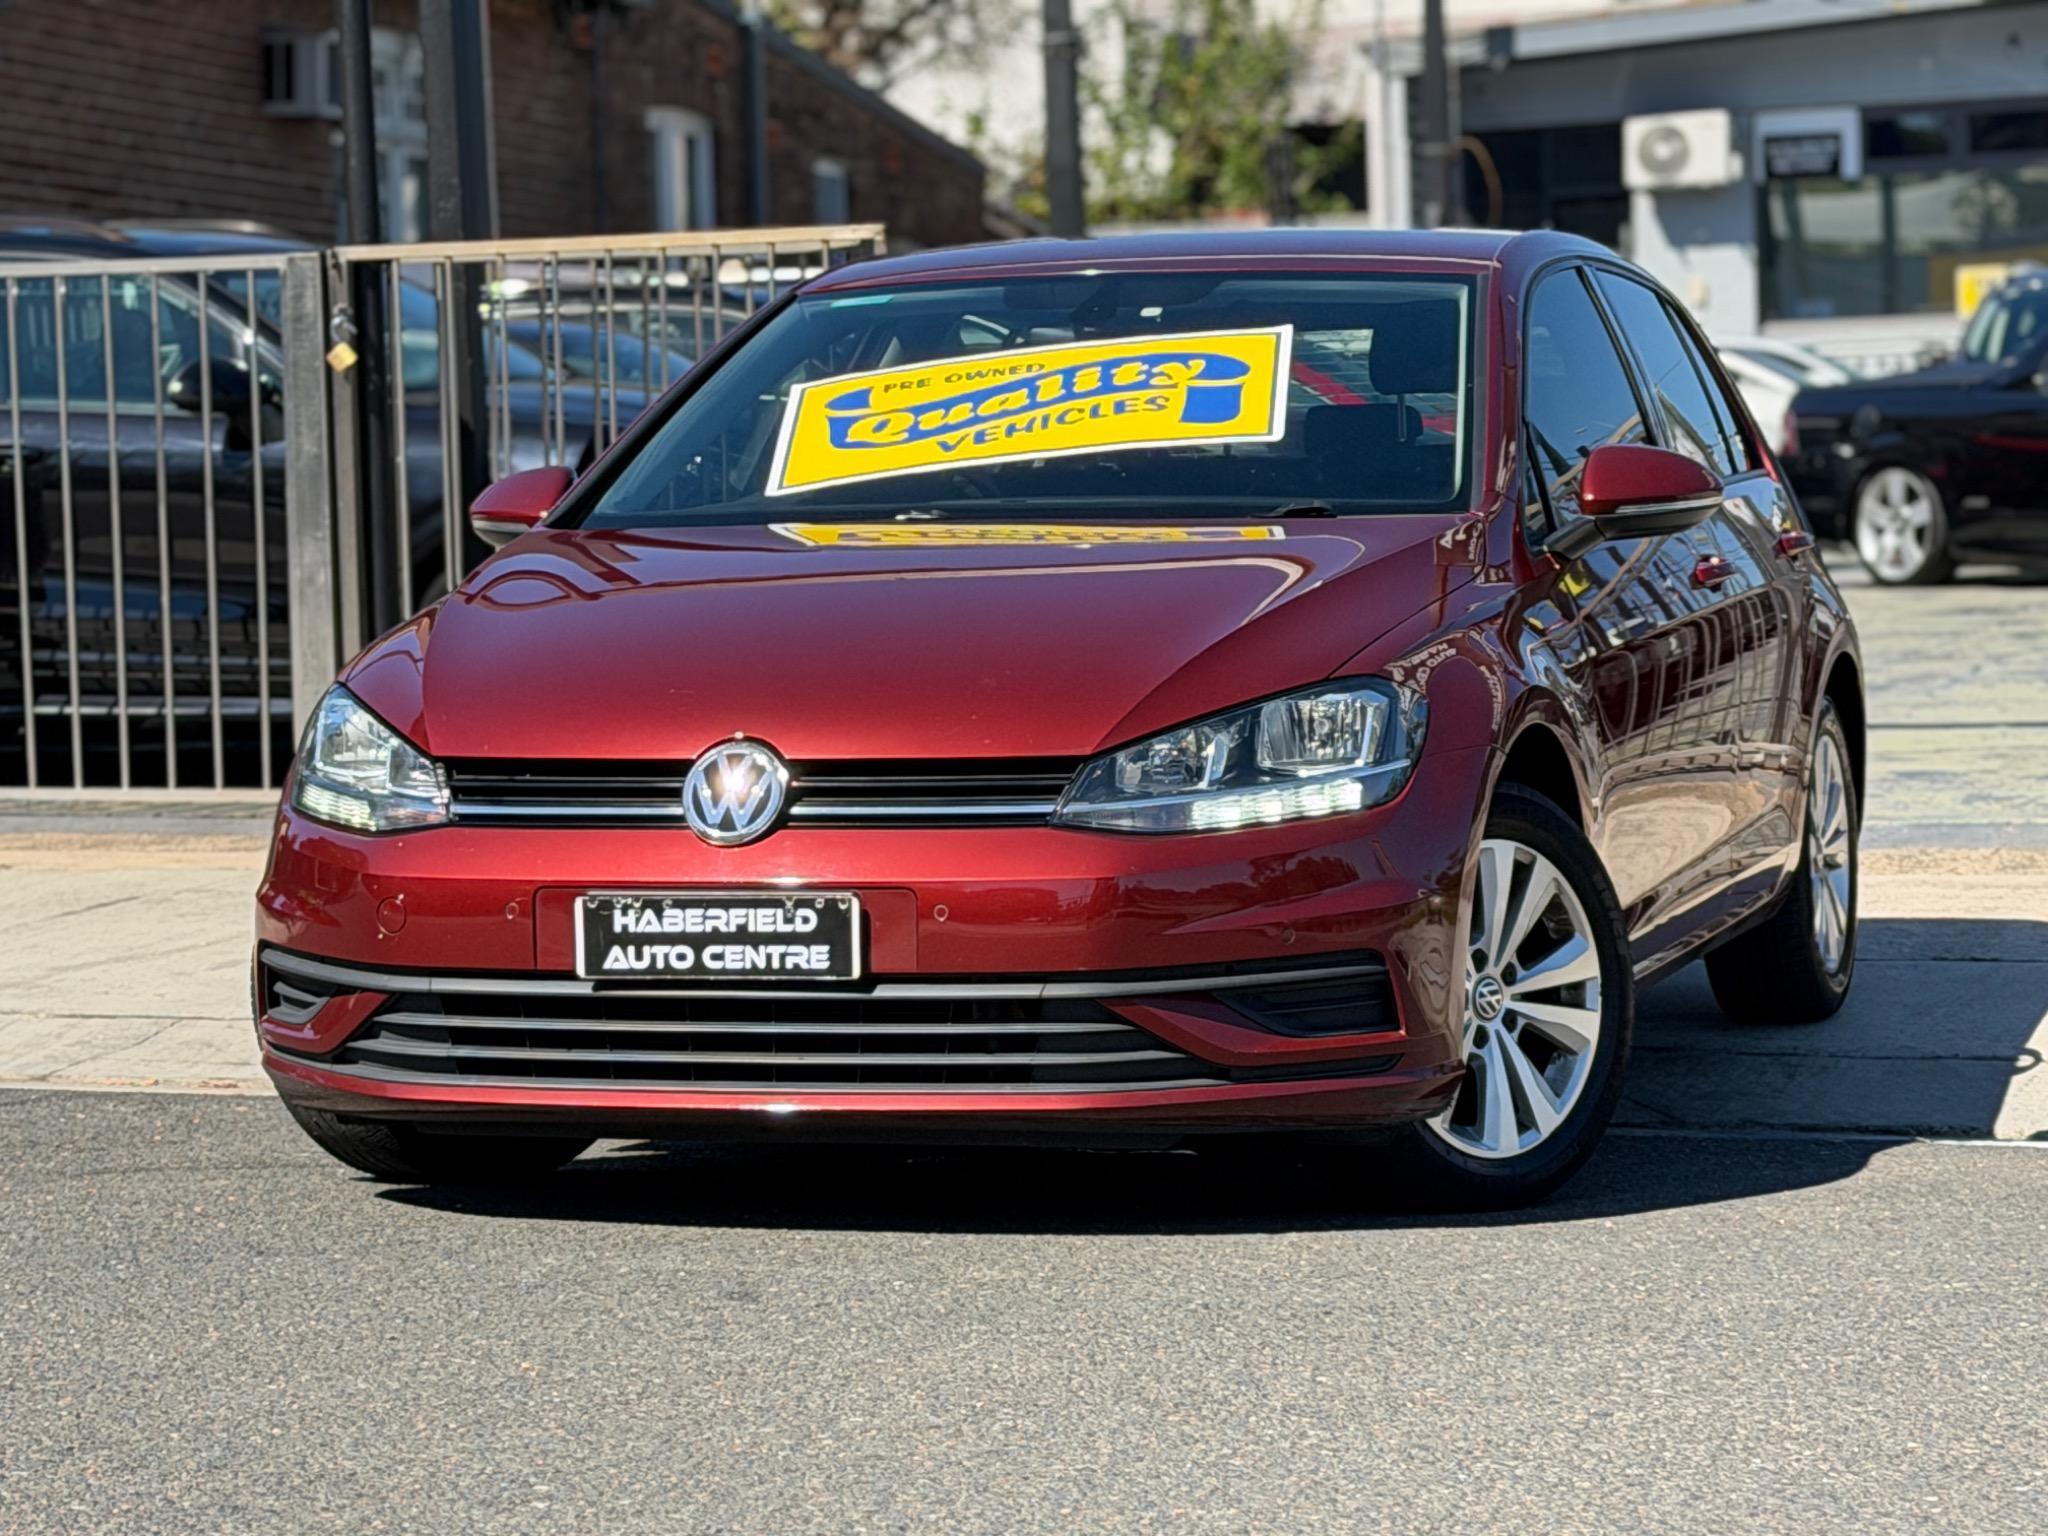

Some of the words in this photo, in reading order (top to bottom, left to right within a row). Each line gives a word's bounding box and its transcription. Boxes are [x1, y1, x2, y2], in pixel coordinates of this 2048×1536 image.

[884, 377, 931, 393] PRE
[944, 363, 1045, 383] OWNED
[845, 359, 1206, 444] Quality
[936, 395, 1171, 452] VEHICLES
[613, 908, 818, 933] HABERFIELD
[602, 945, 695, 970] AUTO
[701, 944, 831, 970] CENTRE
